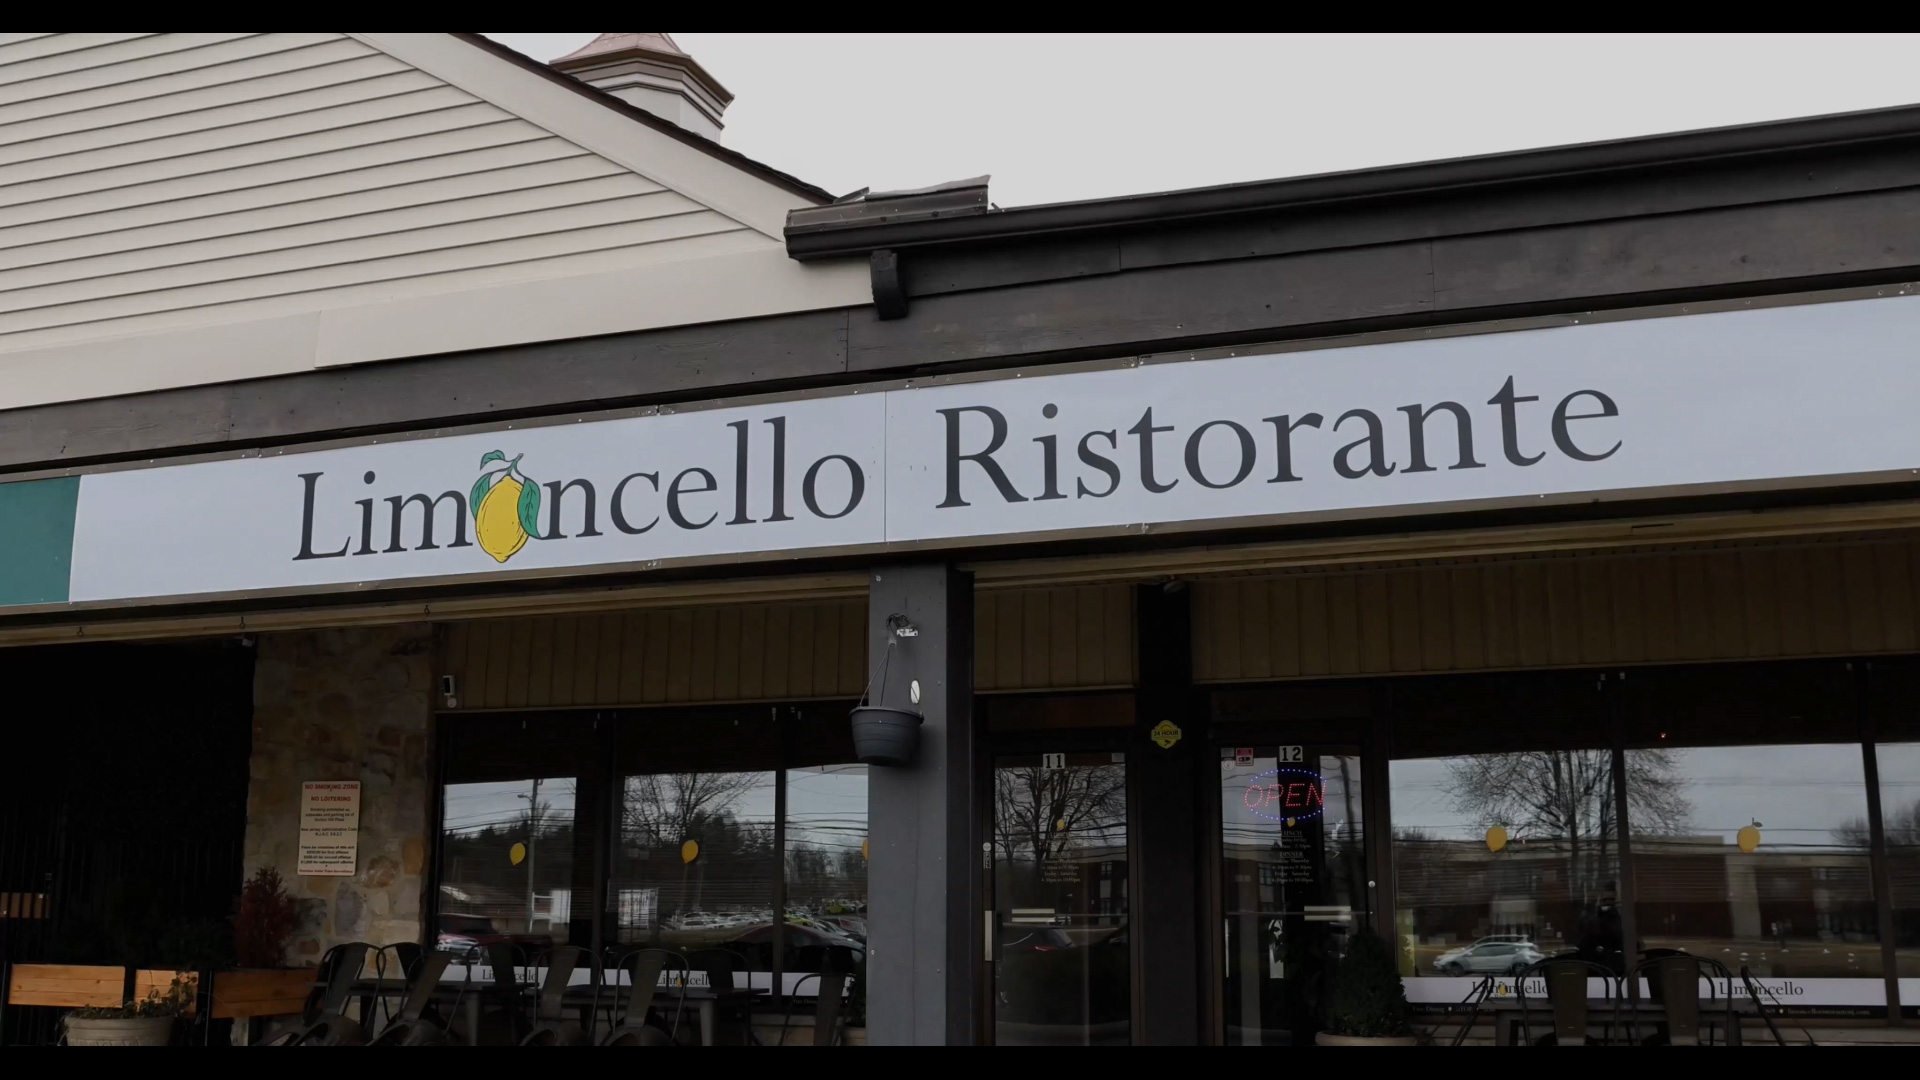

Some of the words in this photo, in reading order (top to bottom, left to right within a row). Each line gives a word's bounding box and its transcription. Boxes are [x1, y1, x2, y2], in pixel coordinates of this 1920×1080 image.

[935, 374, 1624, 509] Ristorante
[1046, 754, 1062, 769] 11
[1282, 746, 1302, 762] 12
[1243, 782, 1328, 808] OPEN
